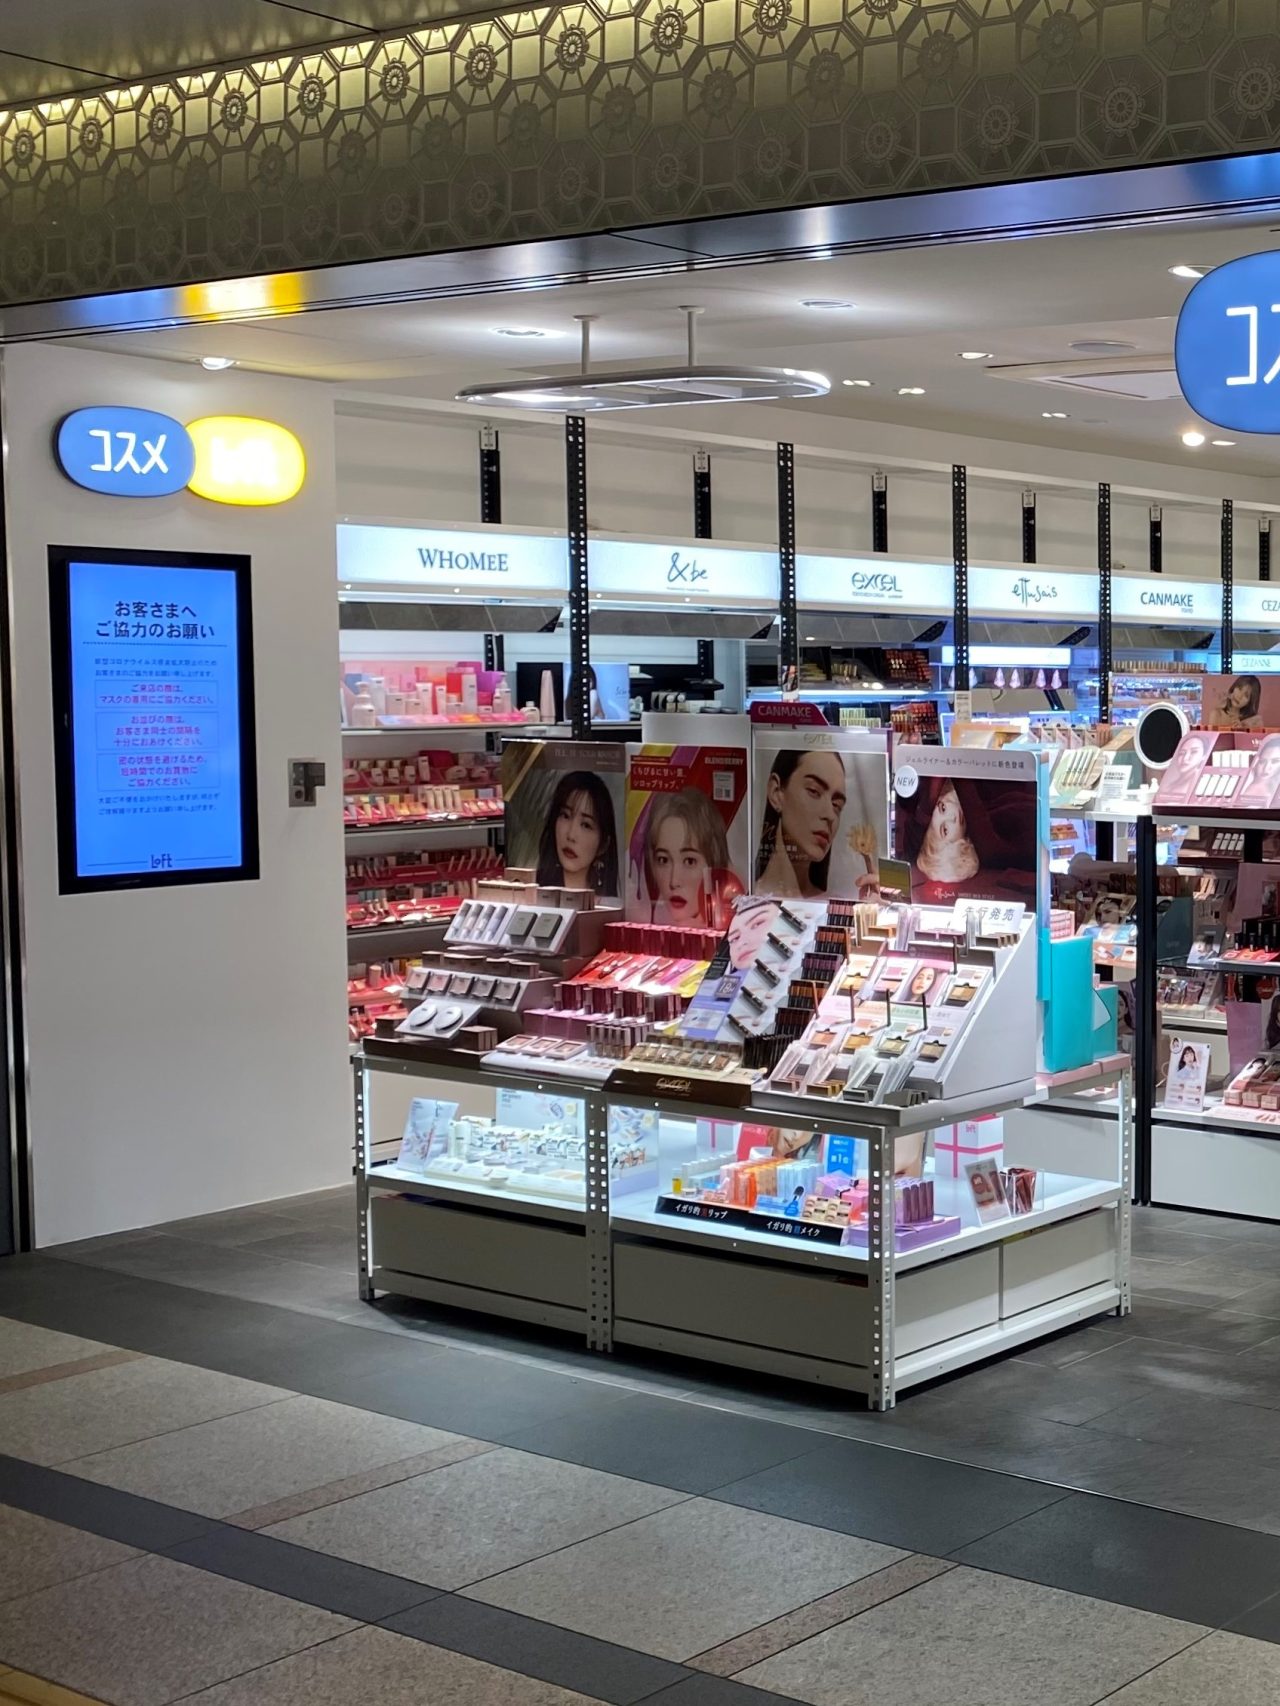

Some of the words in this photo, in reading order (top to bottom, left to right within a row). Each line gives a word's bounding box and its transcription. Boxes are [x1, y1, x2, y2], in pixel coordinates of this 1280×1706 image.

[88, 429, 169, 474] コスメ
[666, 552, 708, 583] &be
[1140, 591, 1194, 608] CANMAKE
[114, 600, 197, 619] お客さまへ
[96, 620, 216, 640] ご協力のお願い
[757, 705, 813, 718] CANMAKE
[896, 776, 916, 787] NEW
